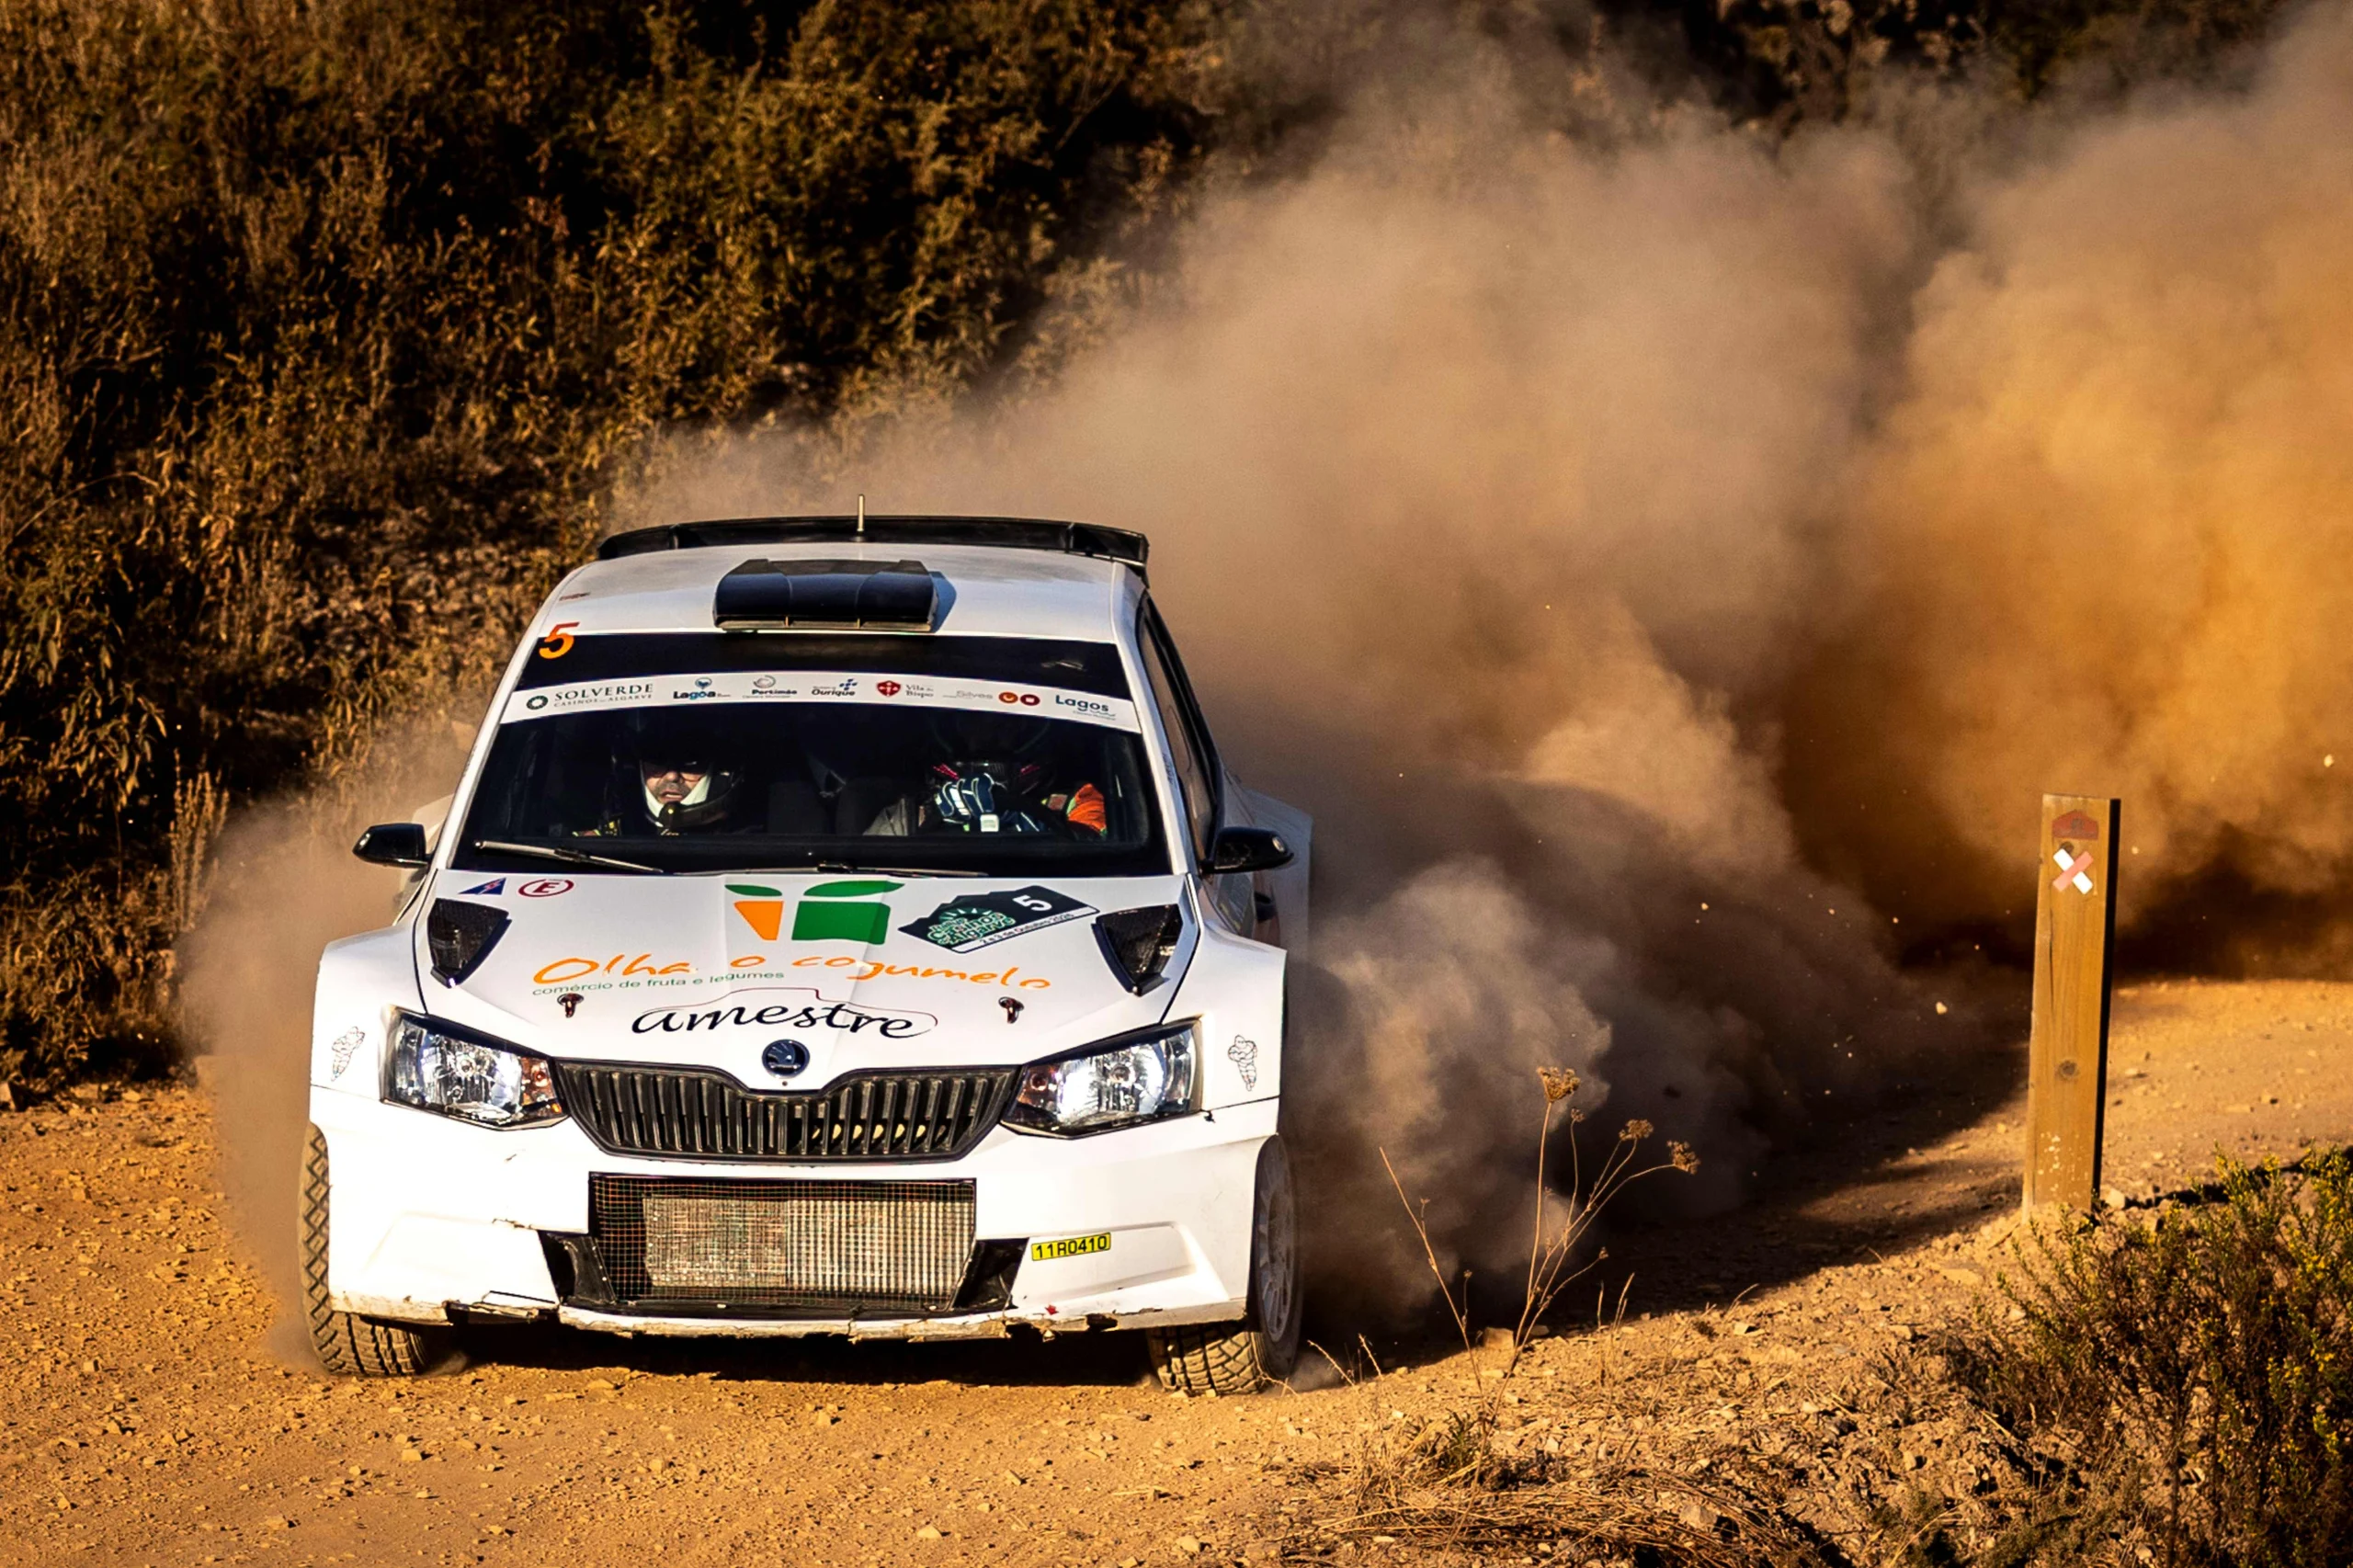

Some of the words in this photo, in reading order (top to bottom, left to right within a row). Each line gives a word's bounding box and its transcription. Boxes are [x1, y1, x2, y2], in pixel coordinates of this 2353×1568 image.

[539, 621, 580, 659] 5
[554, 684, 654, 701] SOLVERDE
[673, 691, 716, 700] Lagoa
[811, 688, 856, 697] Ourique
[1055, 694, 1108, 711] Lagos
[1012, 894, 1052, 911] 5
[533, 953, 692, 984] Olha
[730, 956, 766, 968] o
[792, 956, 1051, 989] cogumelo
[532, 981, 613, 996] comércio
[620, 980, 641, 988] de
[647, 978, 687, 986] fruta
[709, 971, 785, 983] legumes
[631, 1003, 926, 1039] amestre
